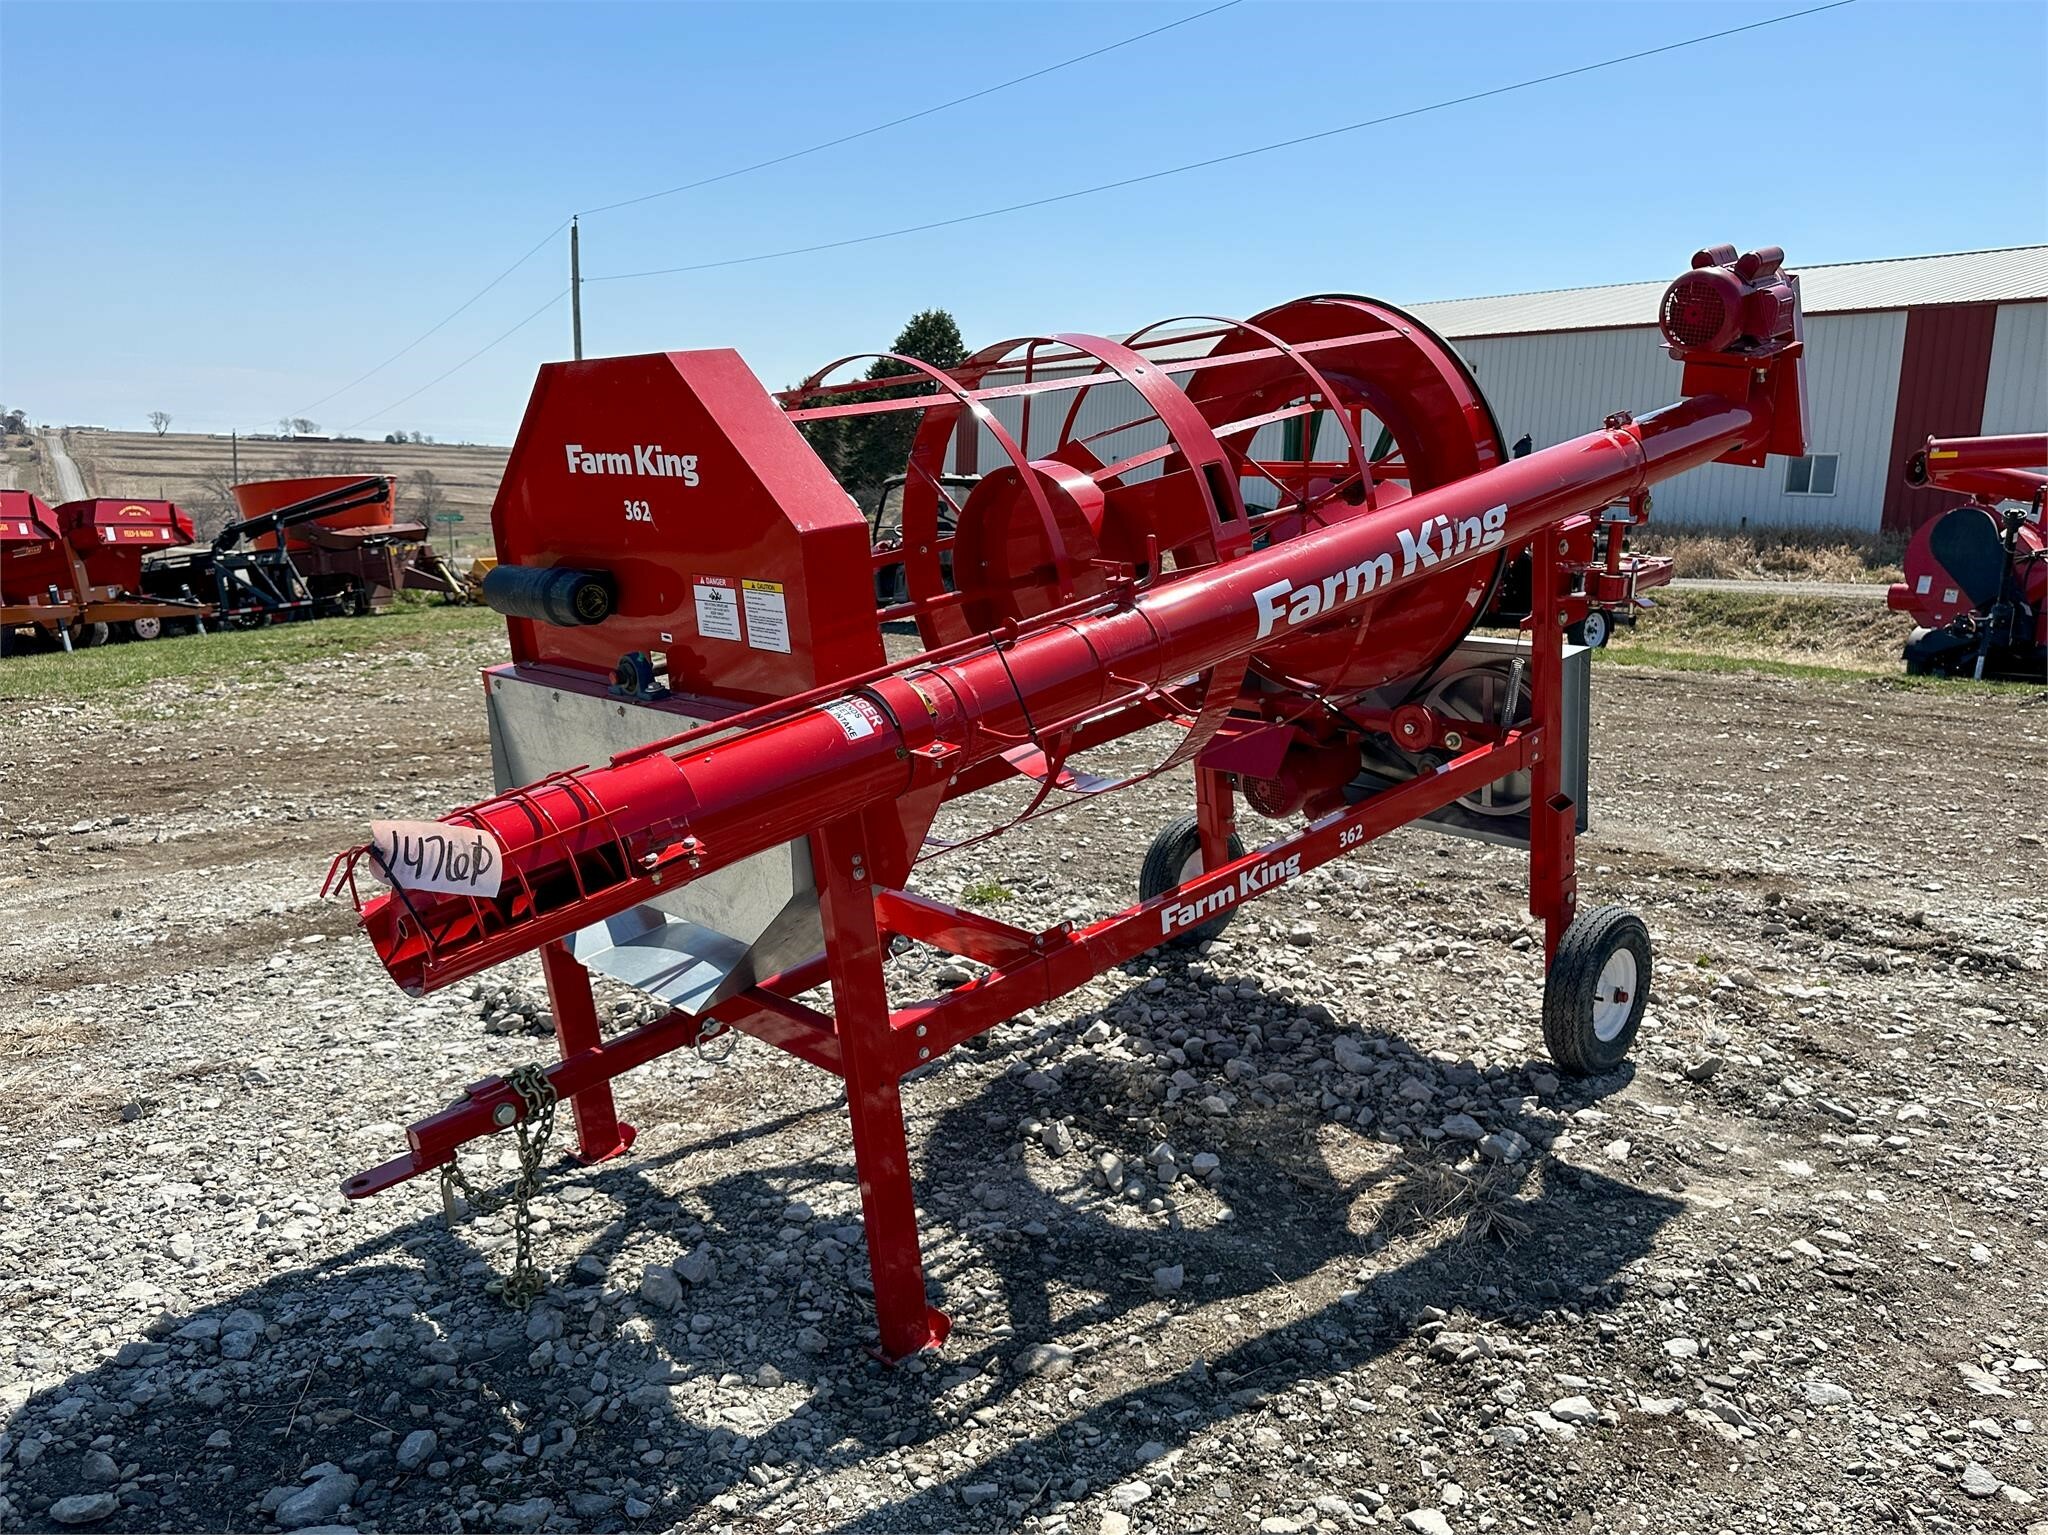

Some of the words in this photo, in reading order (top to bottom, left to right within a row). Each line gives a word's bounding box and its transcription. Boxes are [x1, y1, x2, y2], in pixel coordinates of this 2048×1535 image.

[565, 444, 632, 475] Farm
[633, 445, 699, 487] King
[623, 500, 651, 521] 362
[705, 577, 727, 587] DANGER
[1253, 552, 1394, 640] Farm
[1396, 503, 1508, 577] King
[756, 582, 776, 591] CAUTION
[833, 711, 858, 738] INTAKE
[1339, 824, 1364, 848] 362
[1161, 884, 1236, 935] Farm
[1239, 853, 1301, 897] King
